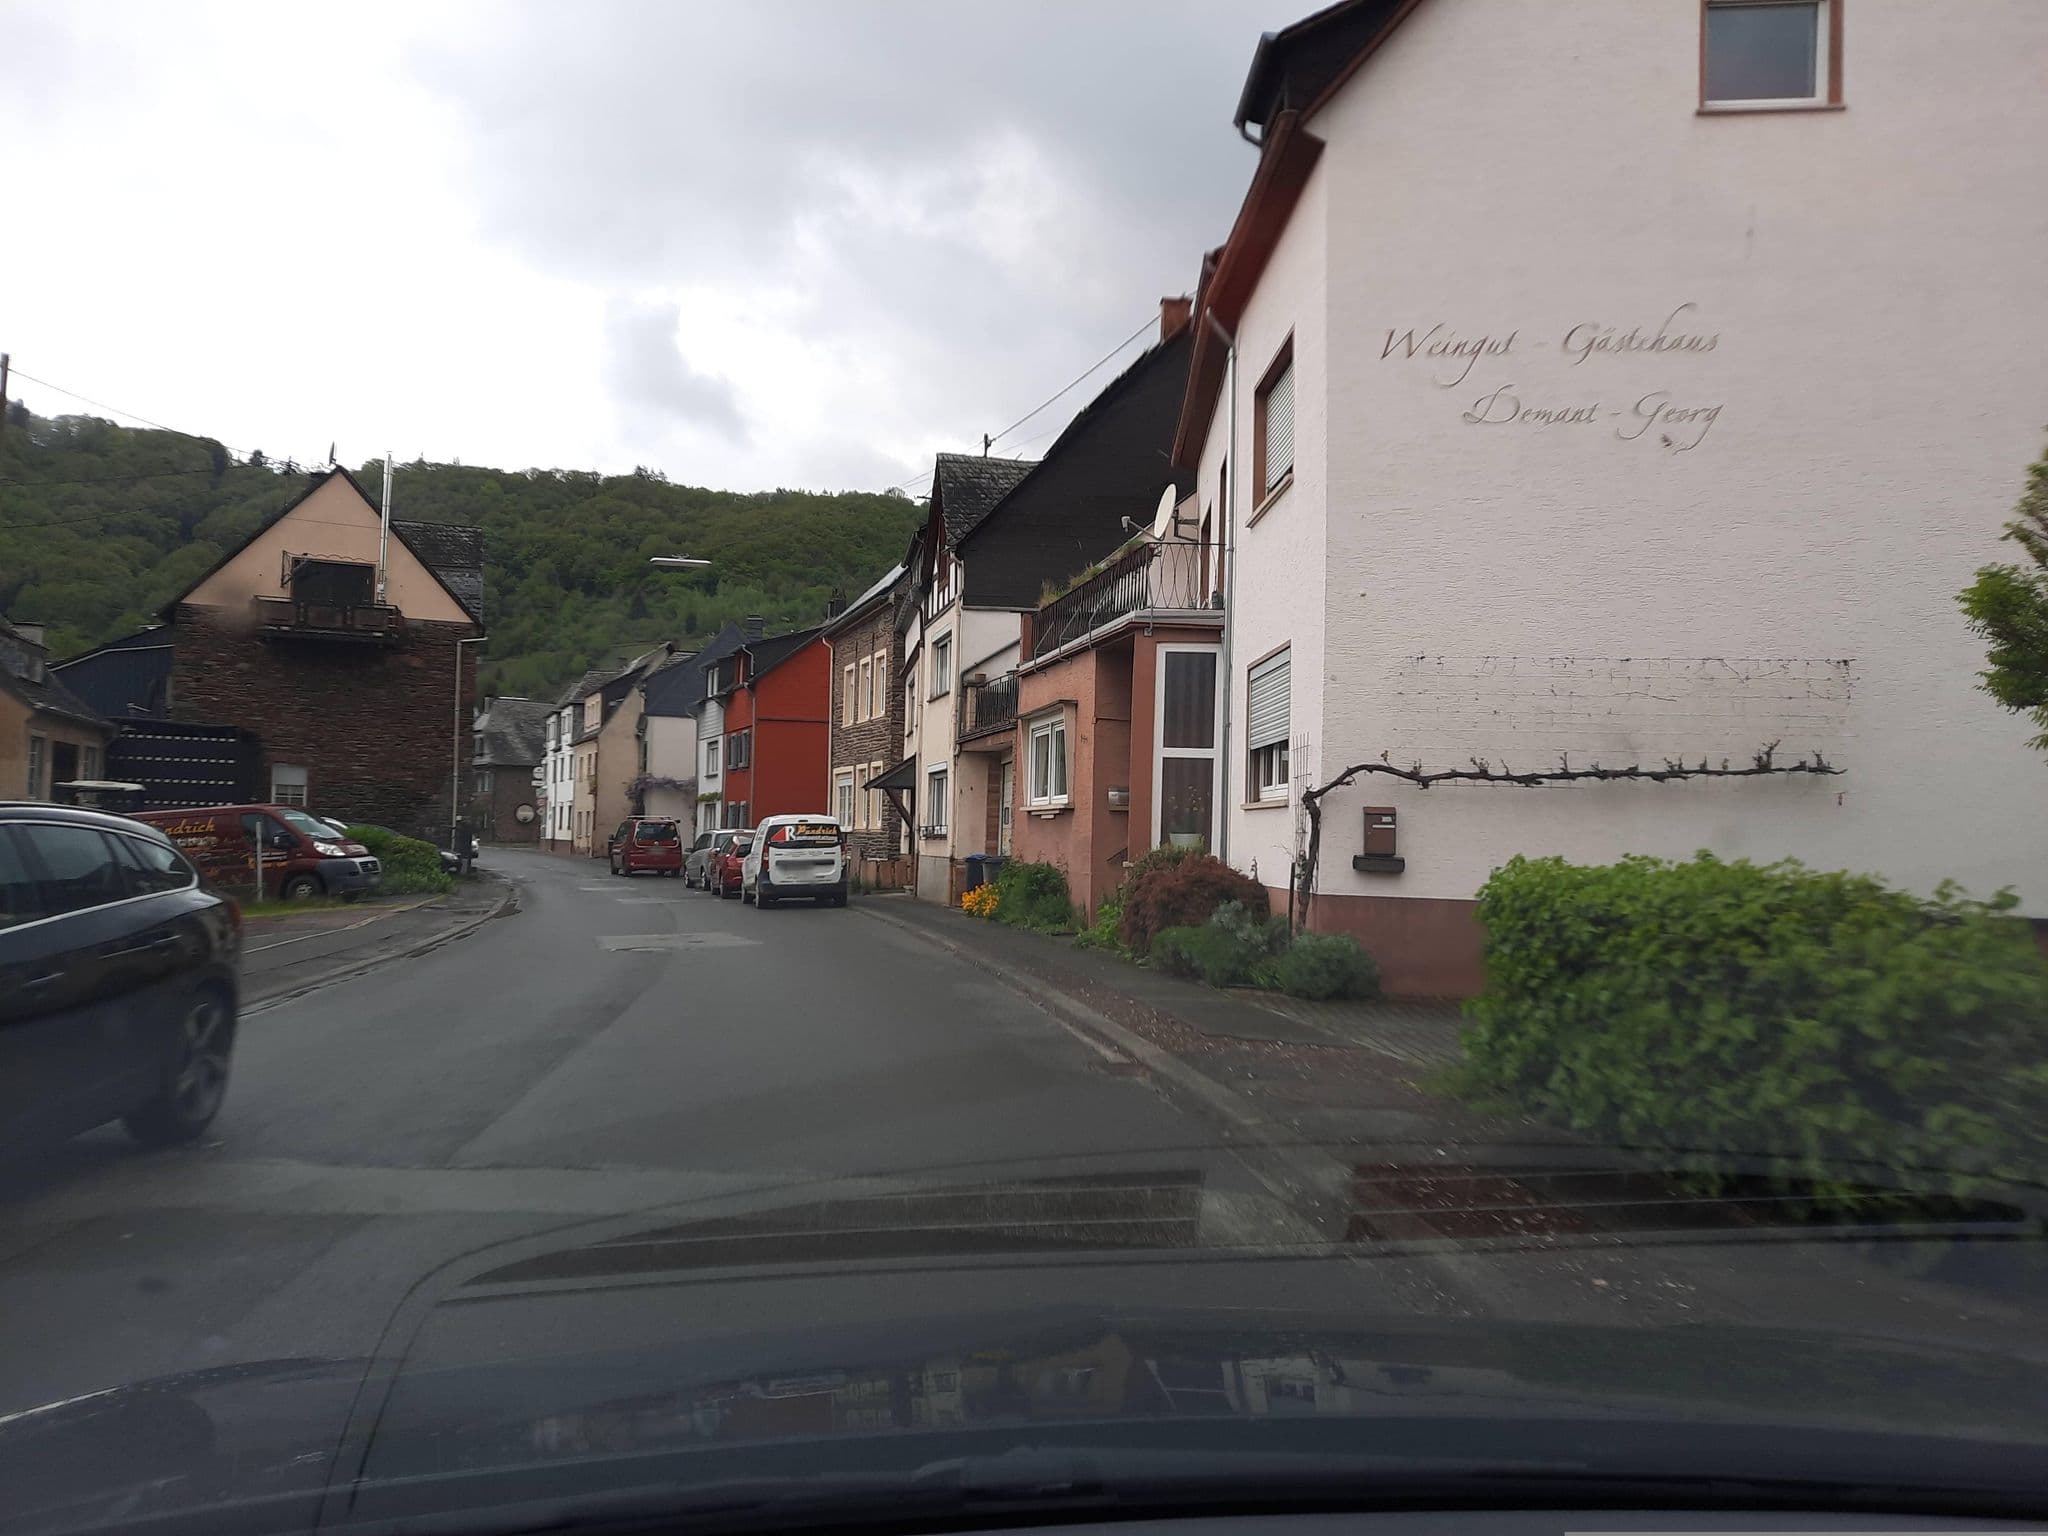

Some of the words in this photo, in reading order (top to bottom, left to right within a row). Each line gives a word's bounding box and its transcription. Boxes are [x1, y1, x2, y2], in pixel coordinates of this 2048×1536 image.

[1380, 322, 1520, 388] Weingut
[1562, 302, 1720, 367] Gästehaus
[1463, 384, 1601, 425] Demant
[1615, 391, 1724, 455] Georg
